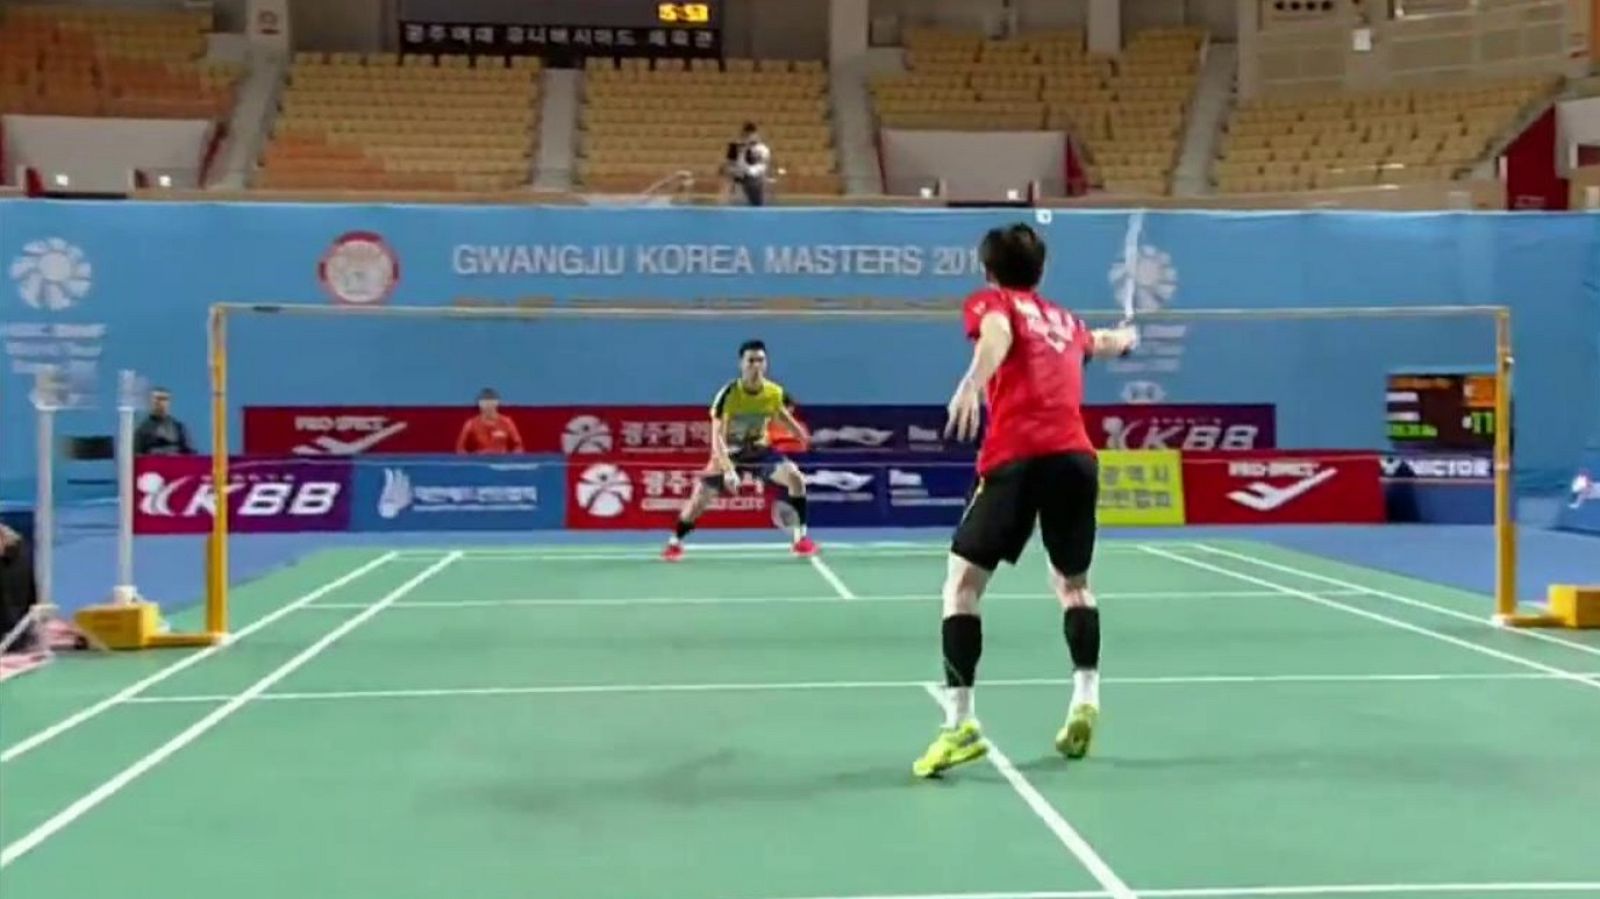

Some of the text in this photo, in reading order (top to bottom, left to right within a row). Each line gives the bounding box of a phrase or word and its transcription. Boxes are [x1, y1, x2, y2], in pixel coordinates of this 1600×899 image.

[452, 244, 979, 275] GWANGJU KOREA MASTERS 201
